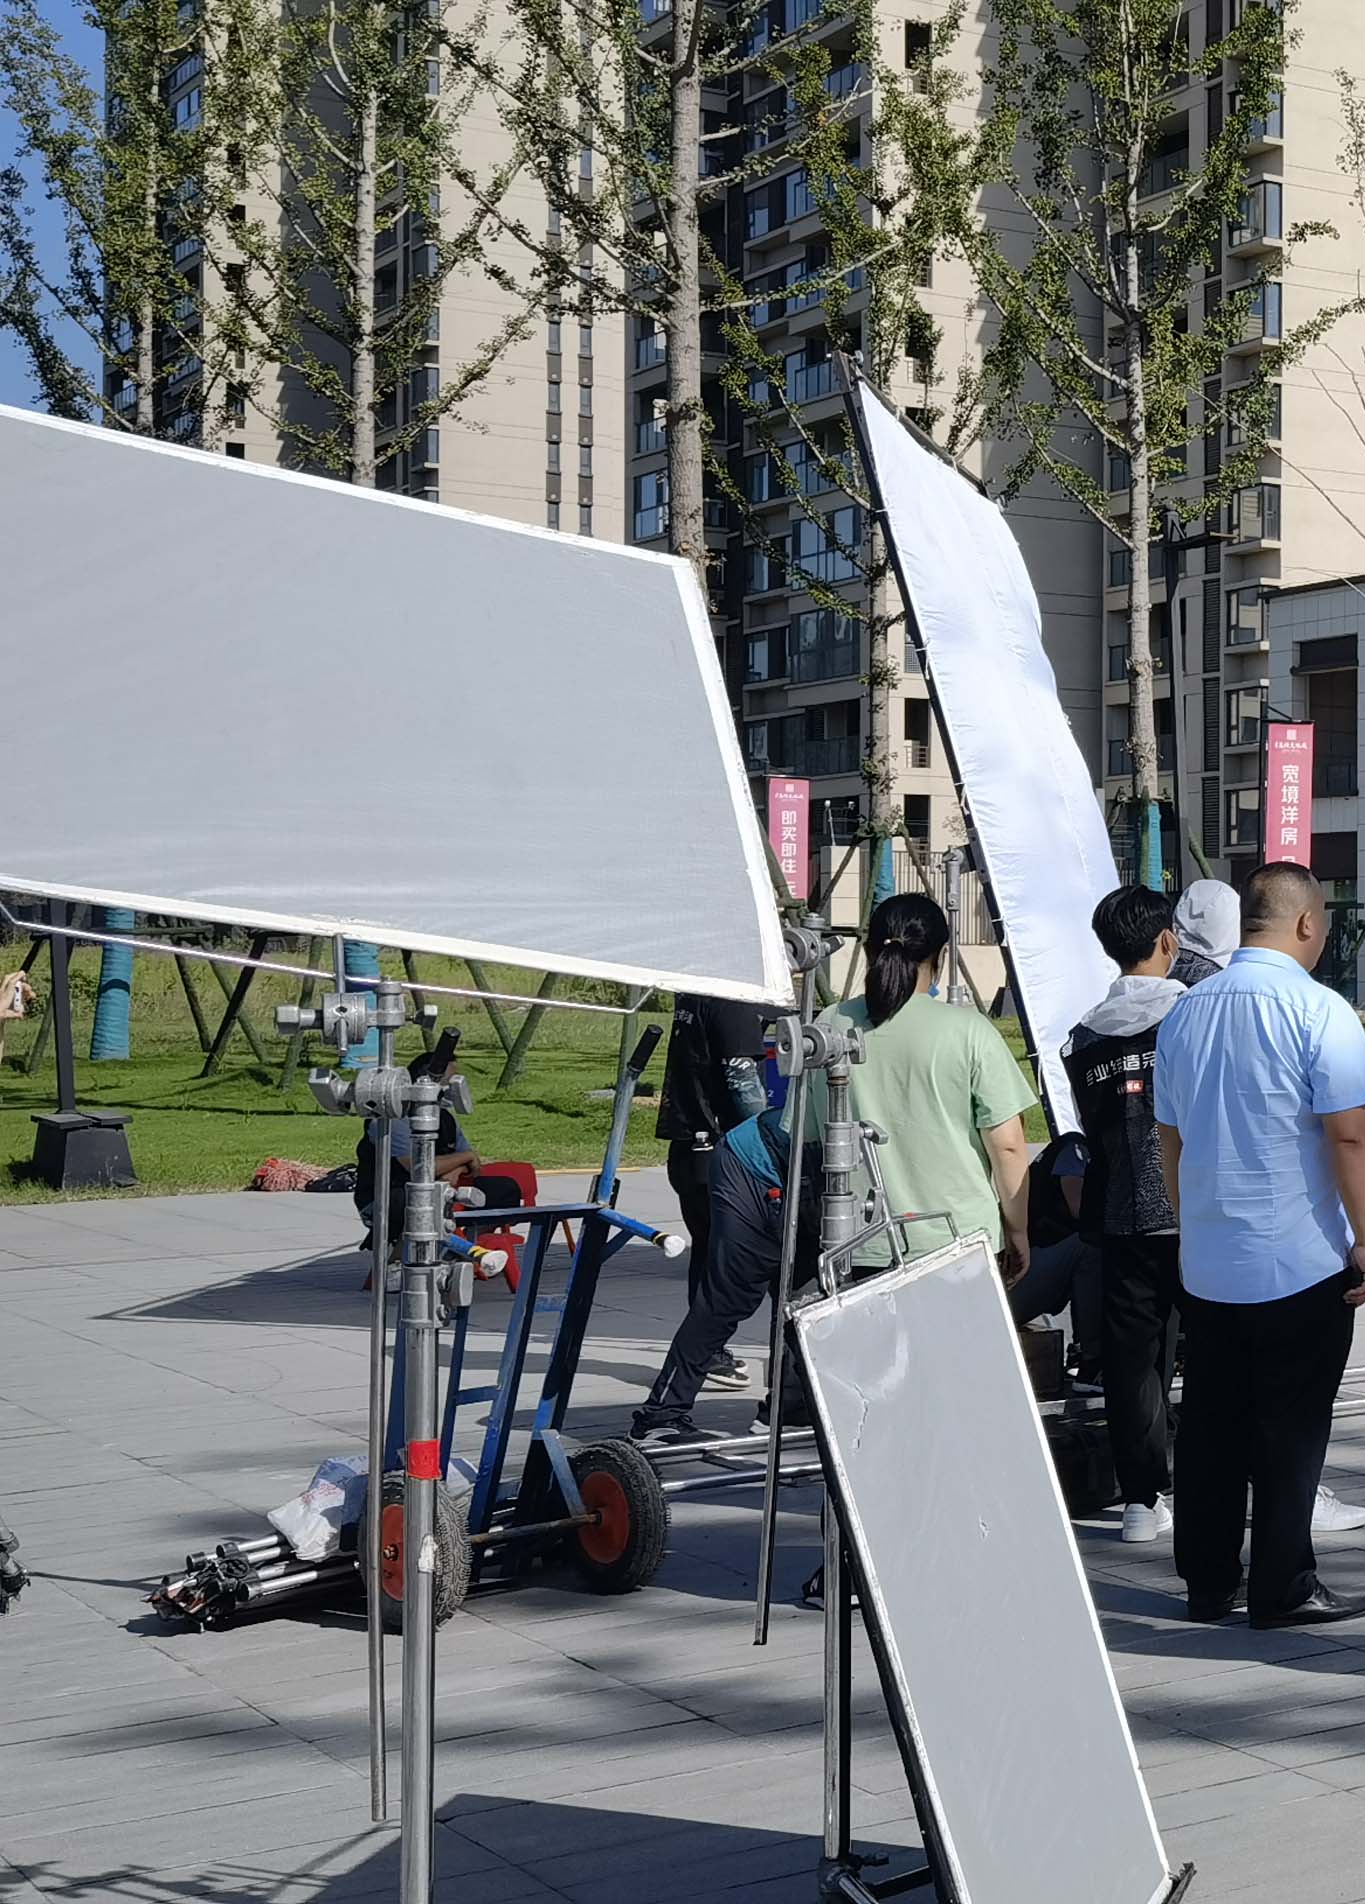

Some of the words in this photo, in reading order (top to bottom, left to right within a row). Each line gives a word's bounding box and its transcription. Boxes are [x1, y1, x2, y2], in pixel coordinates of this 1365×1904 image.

[1280, 764, 1300, 846] 宽境洋房
[781, 810, 797, 874] 即买即住
